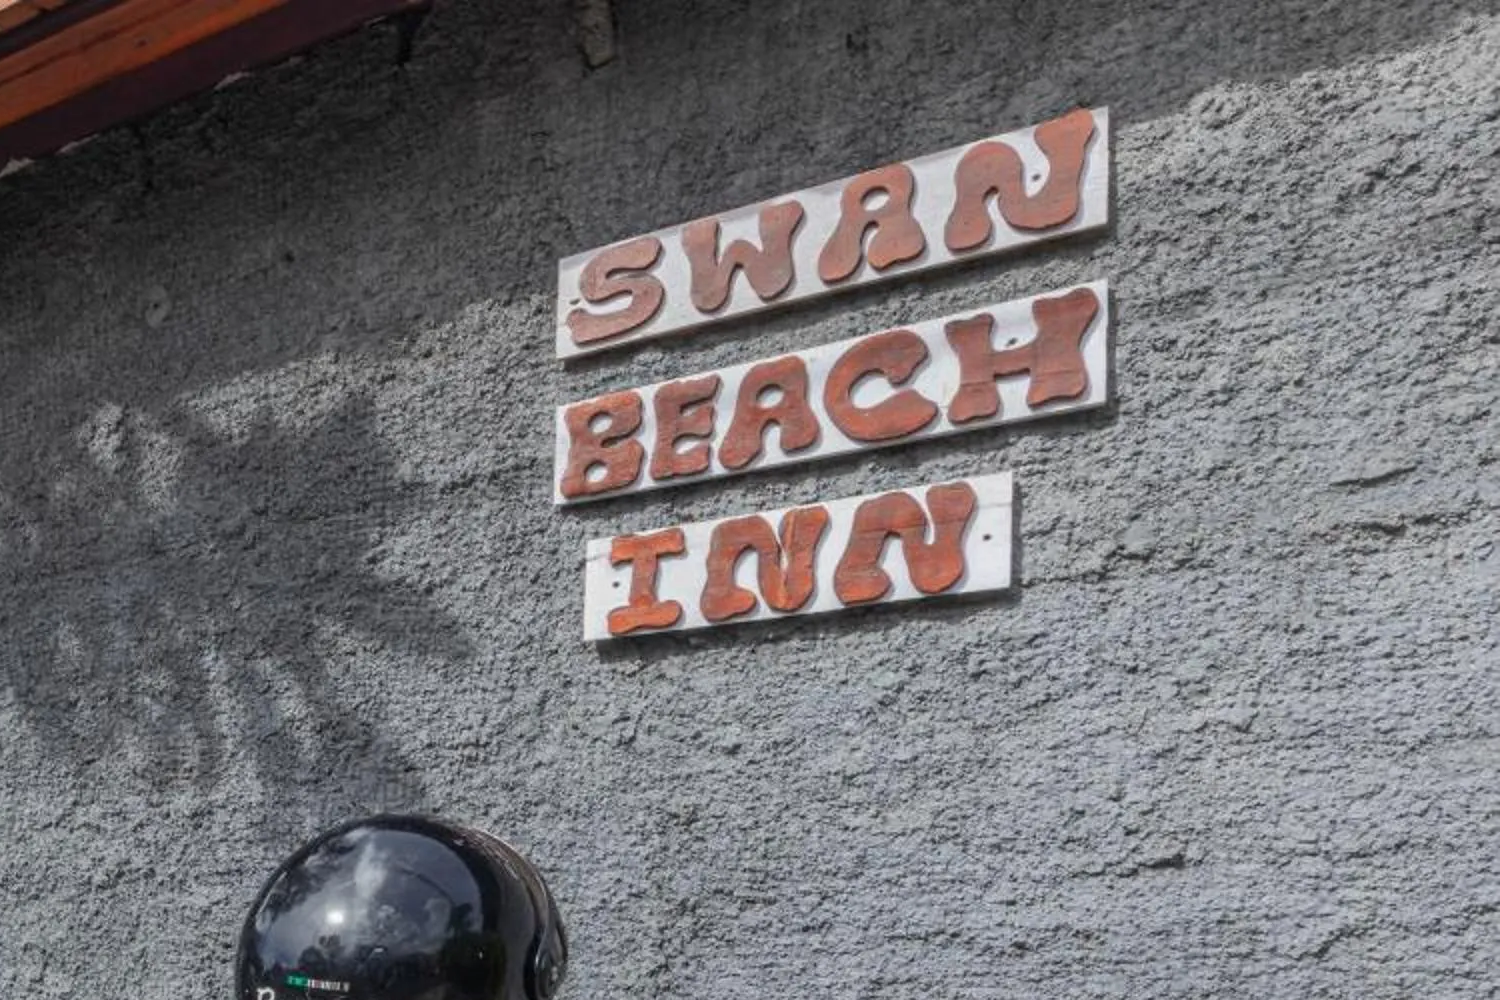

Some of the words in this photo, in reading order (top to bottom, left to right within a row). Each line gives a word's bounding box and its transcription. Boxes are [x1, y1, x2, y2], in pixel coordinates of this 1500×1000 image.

[566, 107, 1094, 344] SWAN
[560, 287, 1100, 499] BEACH
[607, 480, 977, 636] INN
